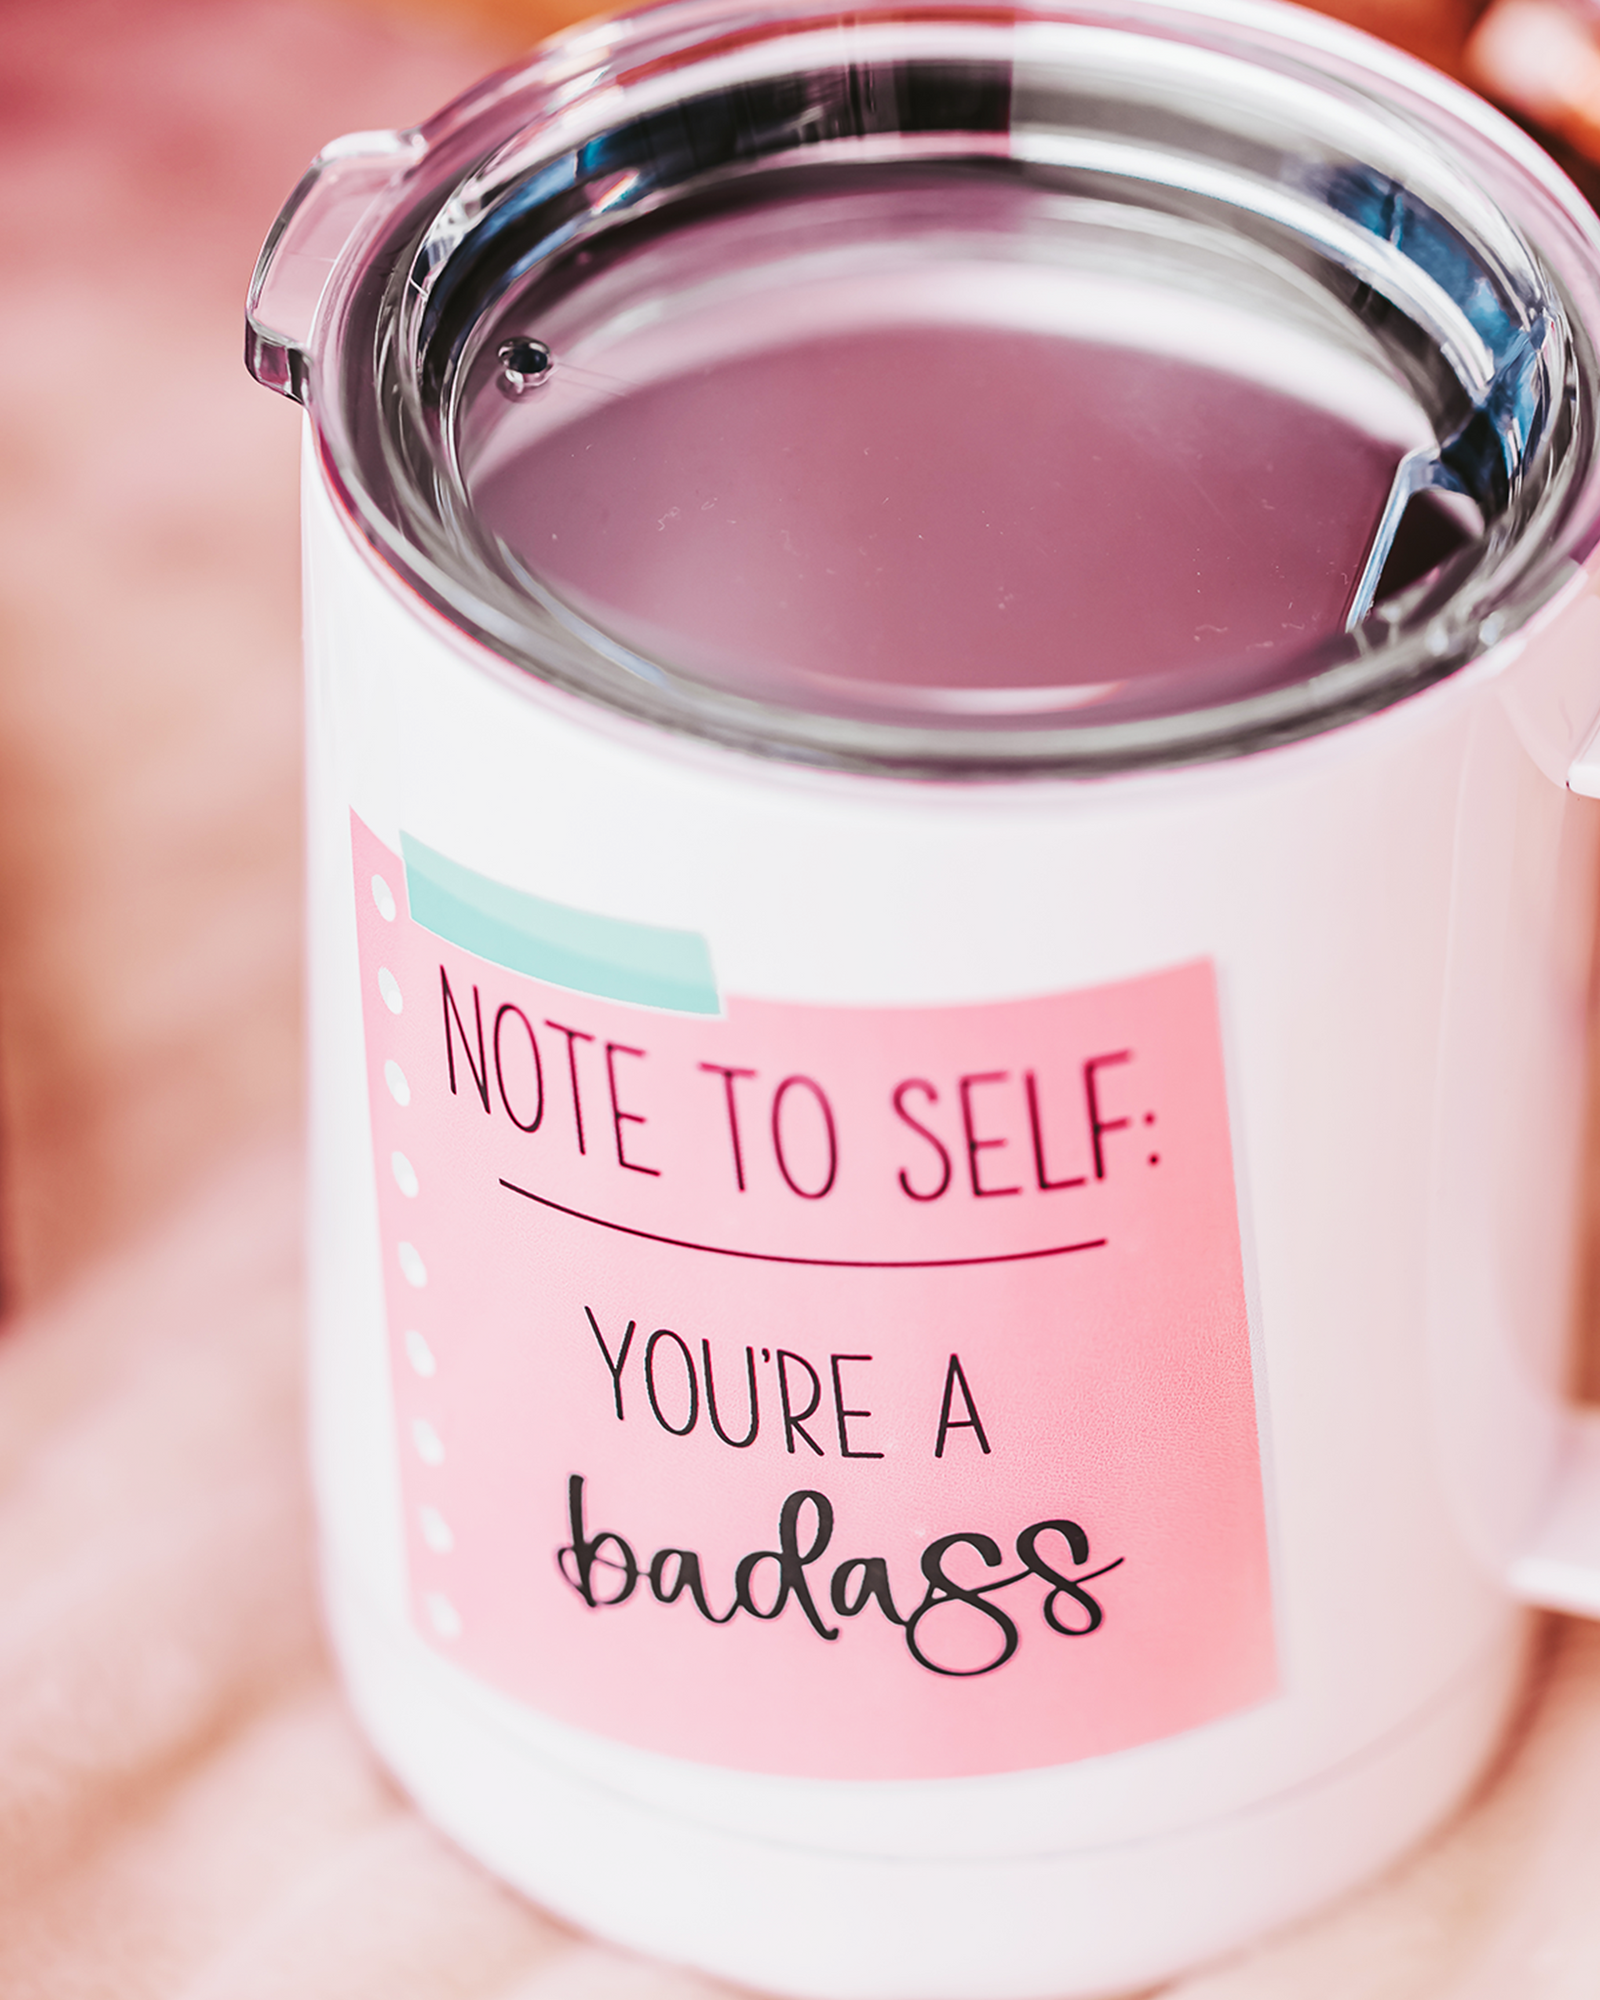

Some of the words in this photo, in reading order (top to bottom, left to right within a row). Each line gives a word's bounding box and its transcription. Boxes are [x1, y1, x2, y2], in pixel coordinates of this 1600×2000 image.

[439, 963, 661, 1177] NOTE
[696, 1060, 838, 1201] TO
[891, 1049, 1161, 1203] SELF:
[584, 1305, 885, 1459] YOU'RE
[934, 1354, 991, 1459] A
[556, 1474, 1126, 1677] badass
